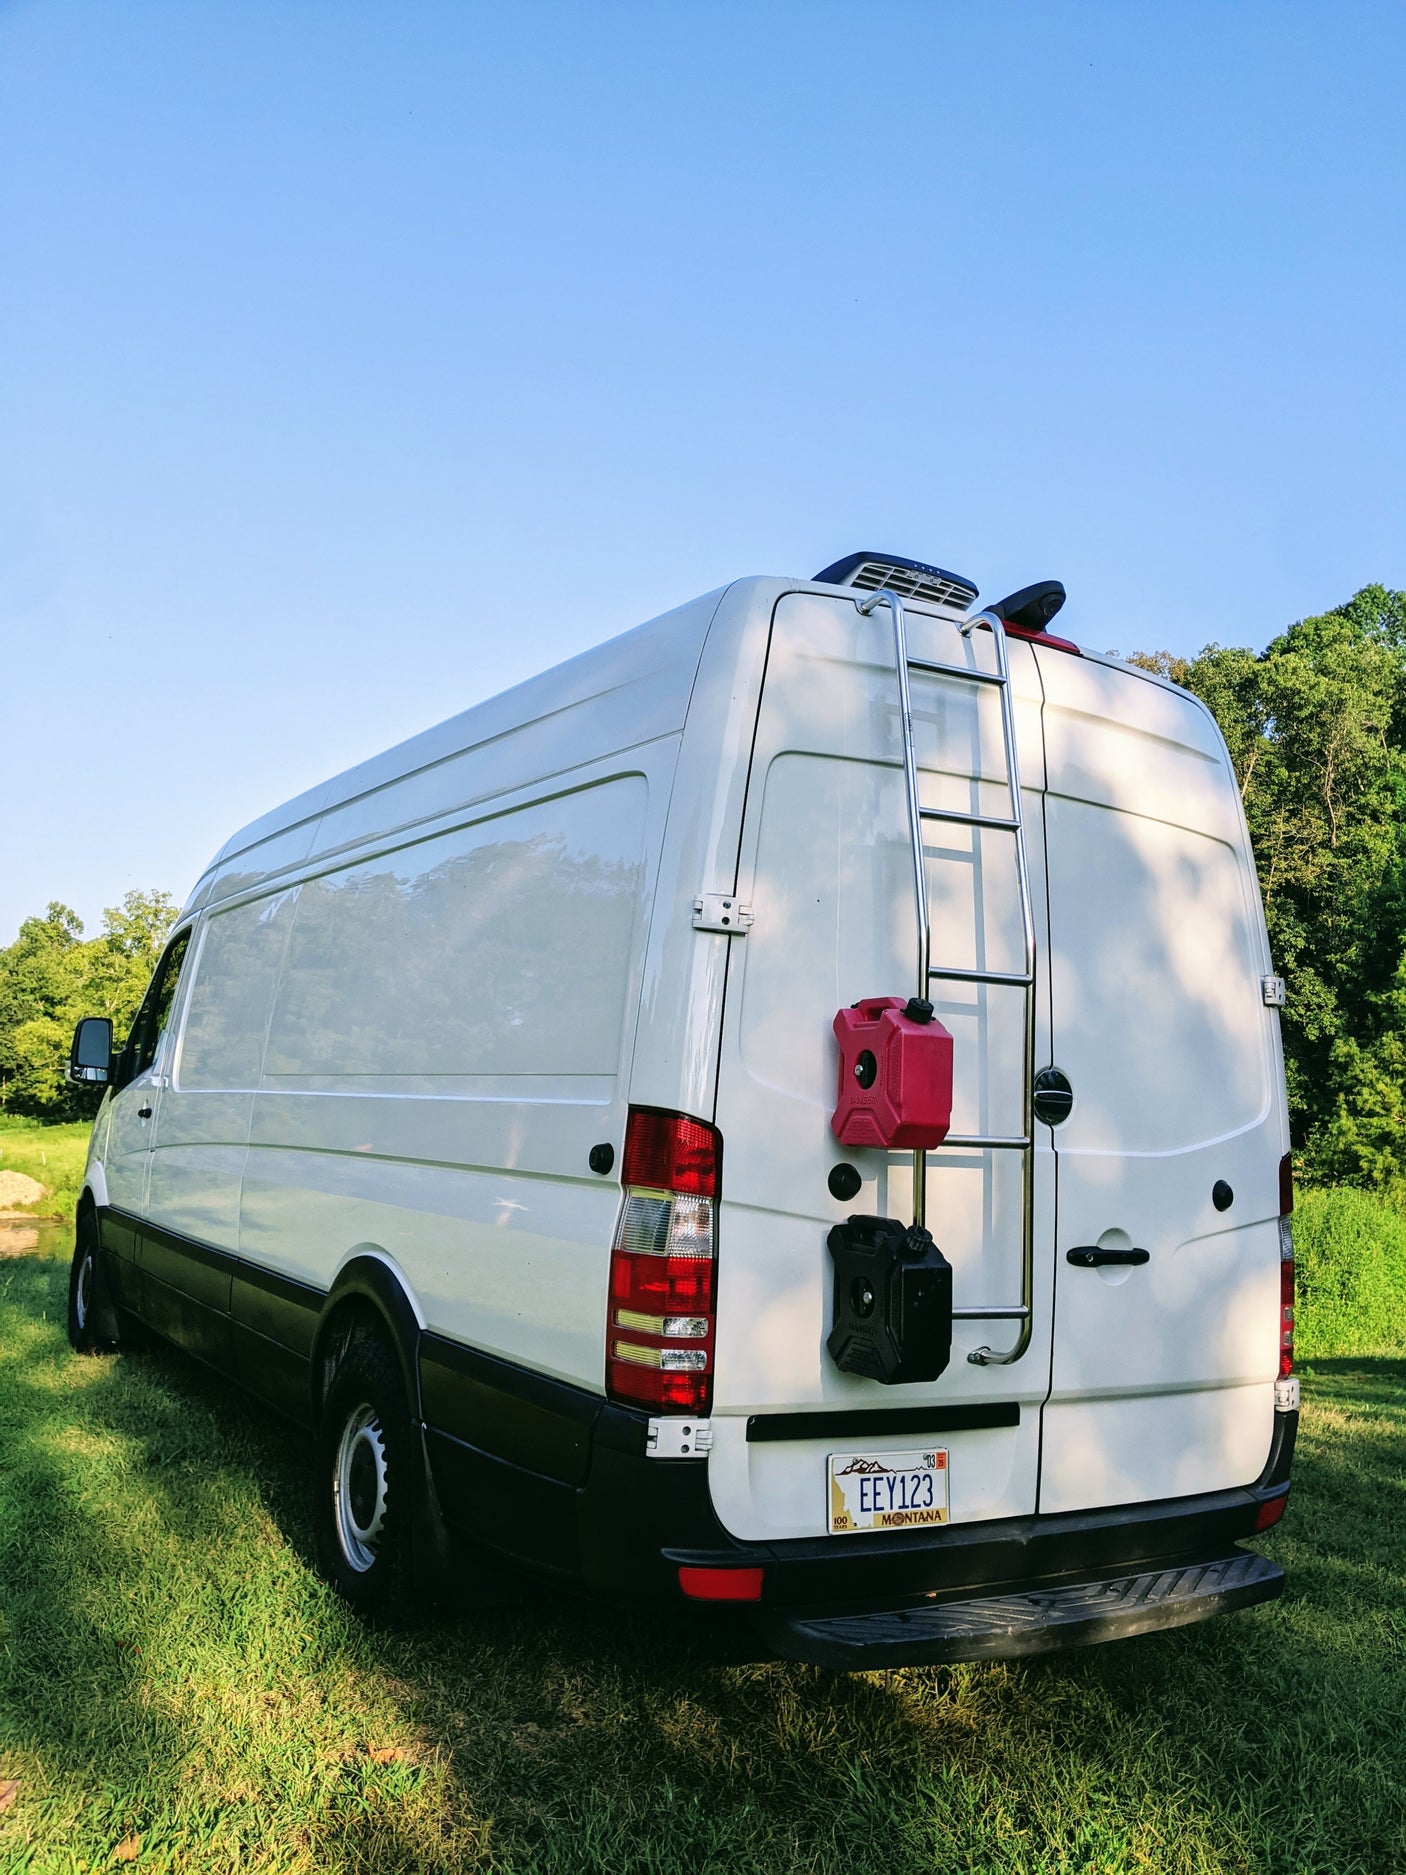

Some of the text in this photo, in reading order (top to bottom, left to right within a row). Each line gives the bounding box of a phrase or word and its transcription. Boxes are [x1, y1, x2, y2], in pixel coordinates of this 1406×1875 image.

[860, 1473, 934, 1512] EEY123
[833, 1516, 848, 1525] 100
[881, 1510, 942, 1526] MONTANA
